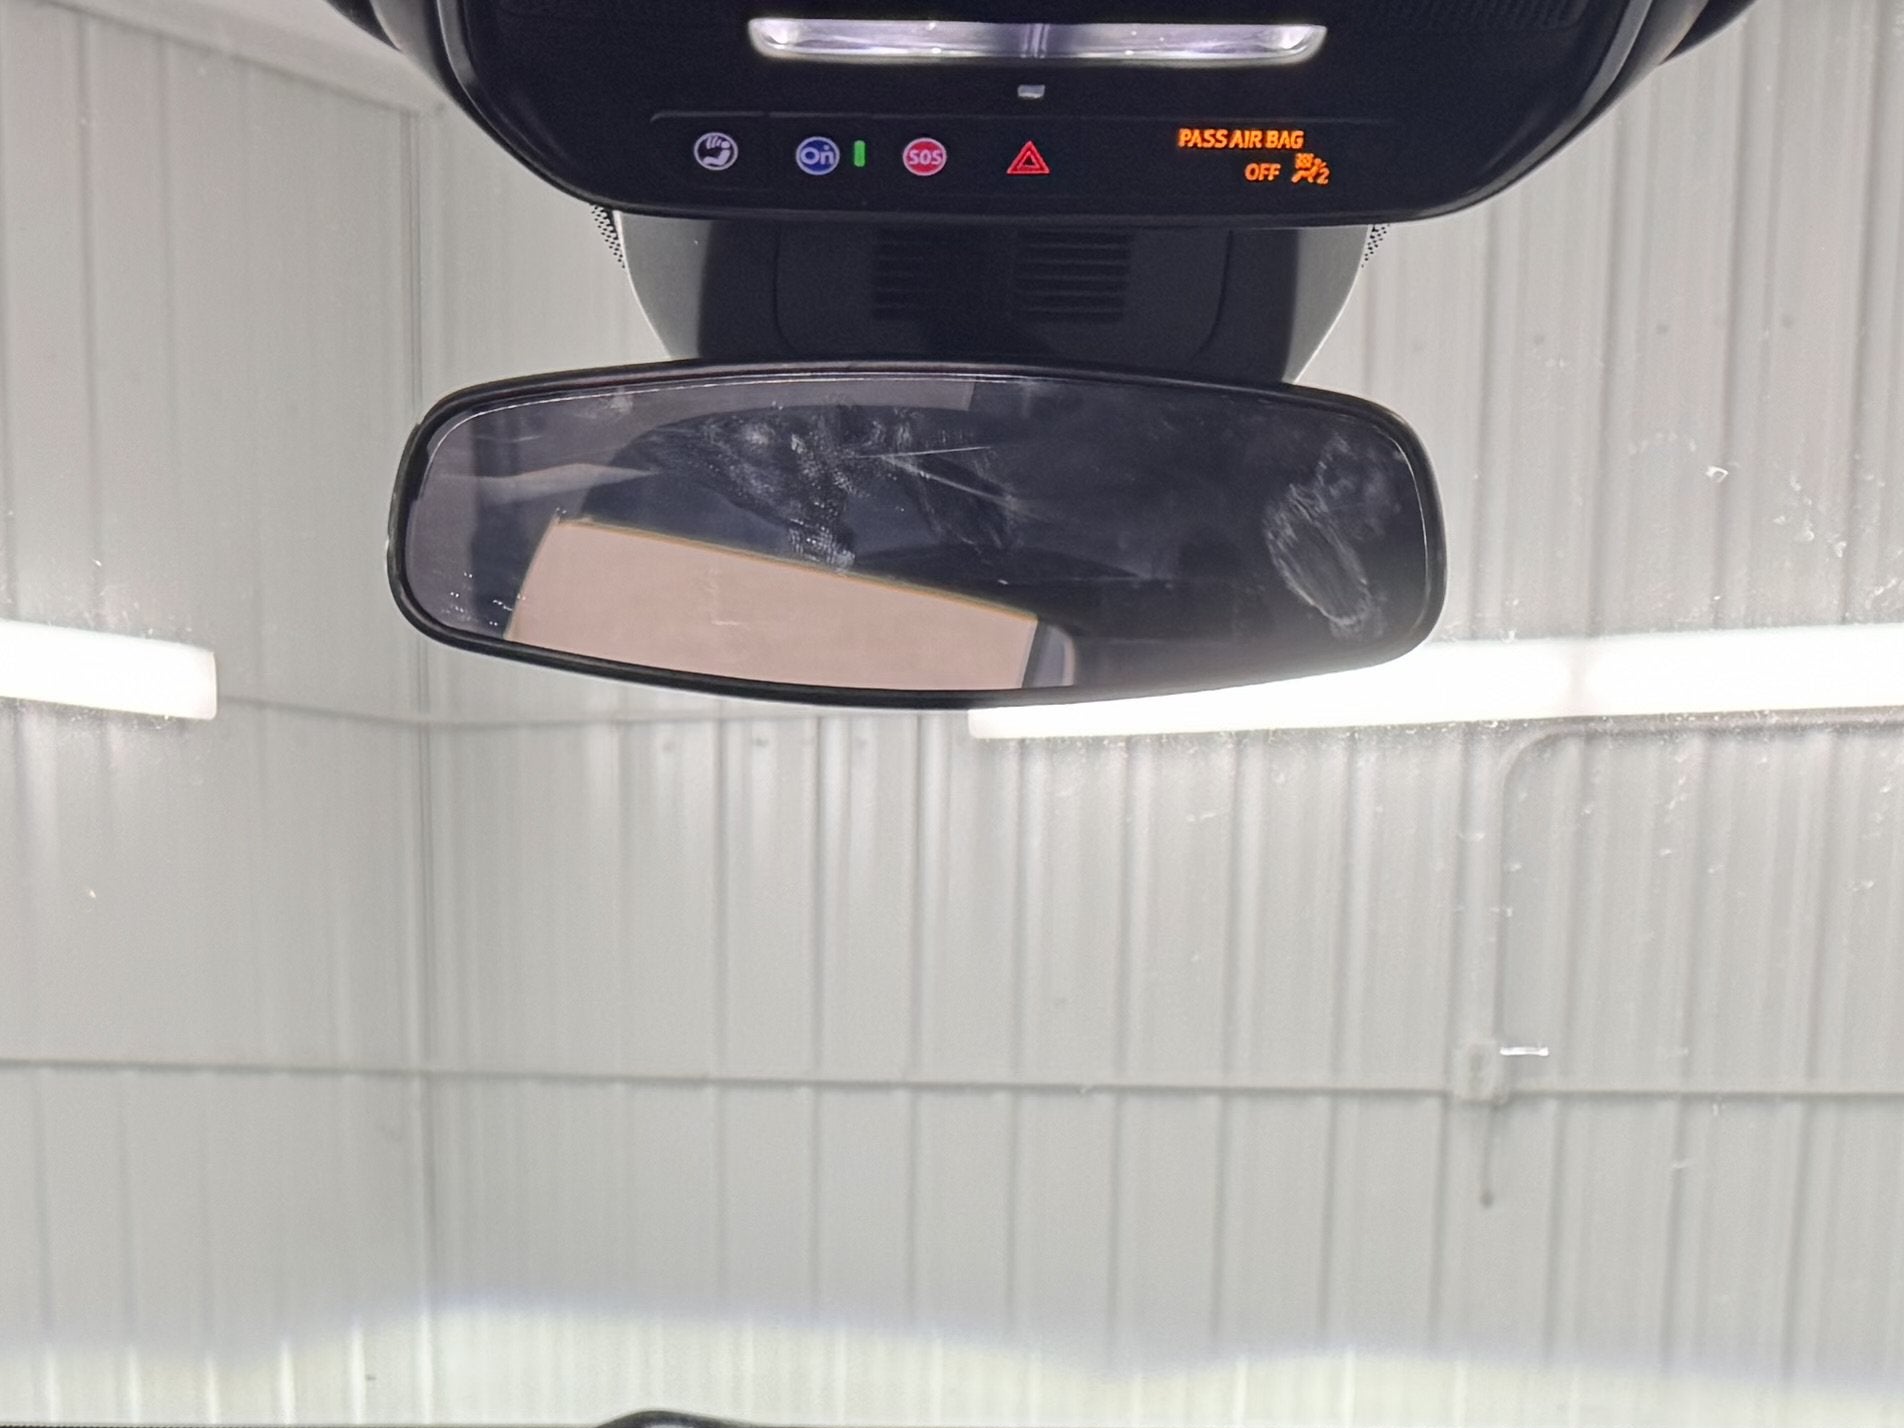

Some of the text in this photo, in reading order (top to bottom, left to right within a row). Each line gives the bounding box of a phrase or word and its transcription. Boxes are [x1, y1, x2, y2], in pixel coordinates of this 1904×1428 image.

[1178, 129, 1304, 150] PASS AIR BAG
[909, 148, 942, 165] SOS
[1244, 163, 1280, 182] OFF
